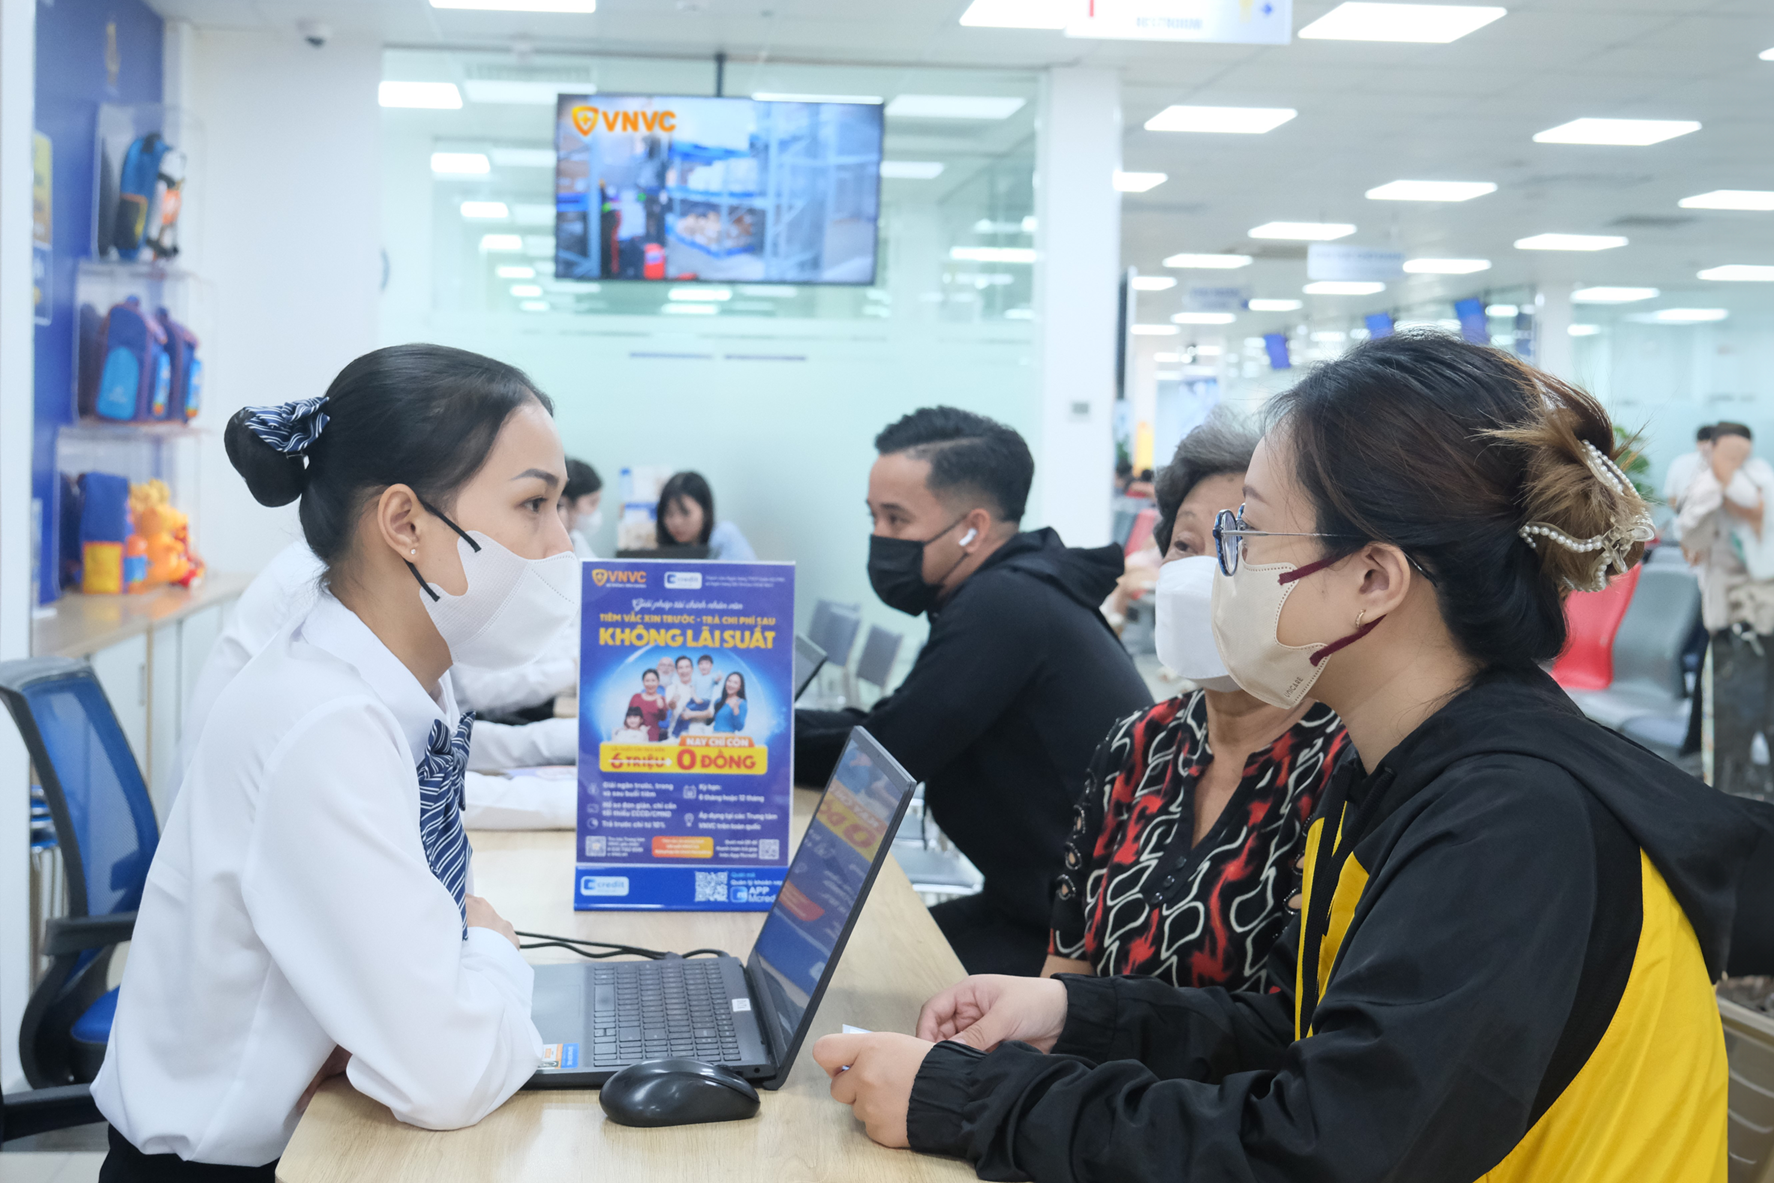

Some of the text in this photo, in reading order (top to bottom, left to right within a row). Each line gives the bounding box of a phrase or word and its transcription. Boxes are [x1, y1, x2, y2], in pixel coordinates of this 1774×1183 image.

[602, 110, 676, 133] VNVC
[607, 571, 647, 584] VNVC
[599, 612, 622, 622] TIÊM
[623, 610, 643, 622] VẮC
[644, 614, 661, 623] XIN
[662, 613, 695, 624] TRƯỚC
[702, 613, 720, 624] TRẢ
[722, 616, 738, 625] CHI
[739, 615, 756, 625] PHÍ
[756, 616, 776, 626] SAU
[599, 624, 776, 649] KHÔNG LÃI SUẤT
[686, 737, 707, 746] NAY
[625, 753, 665, 770] TRIỆU
[677, 748, 756, 770] 0 ĐỒNG
[746, 794, 765, 803] tháng
[746, 812, 765, 821] Trung
[749, 886, 770, 895] APP
[748, 894, 776, 903] Mcred
